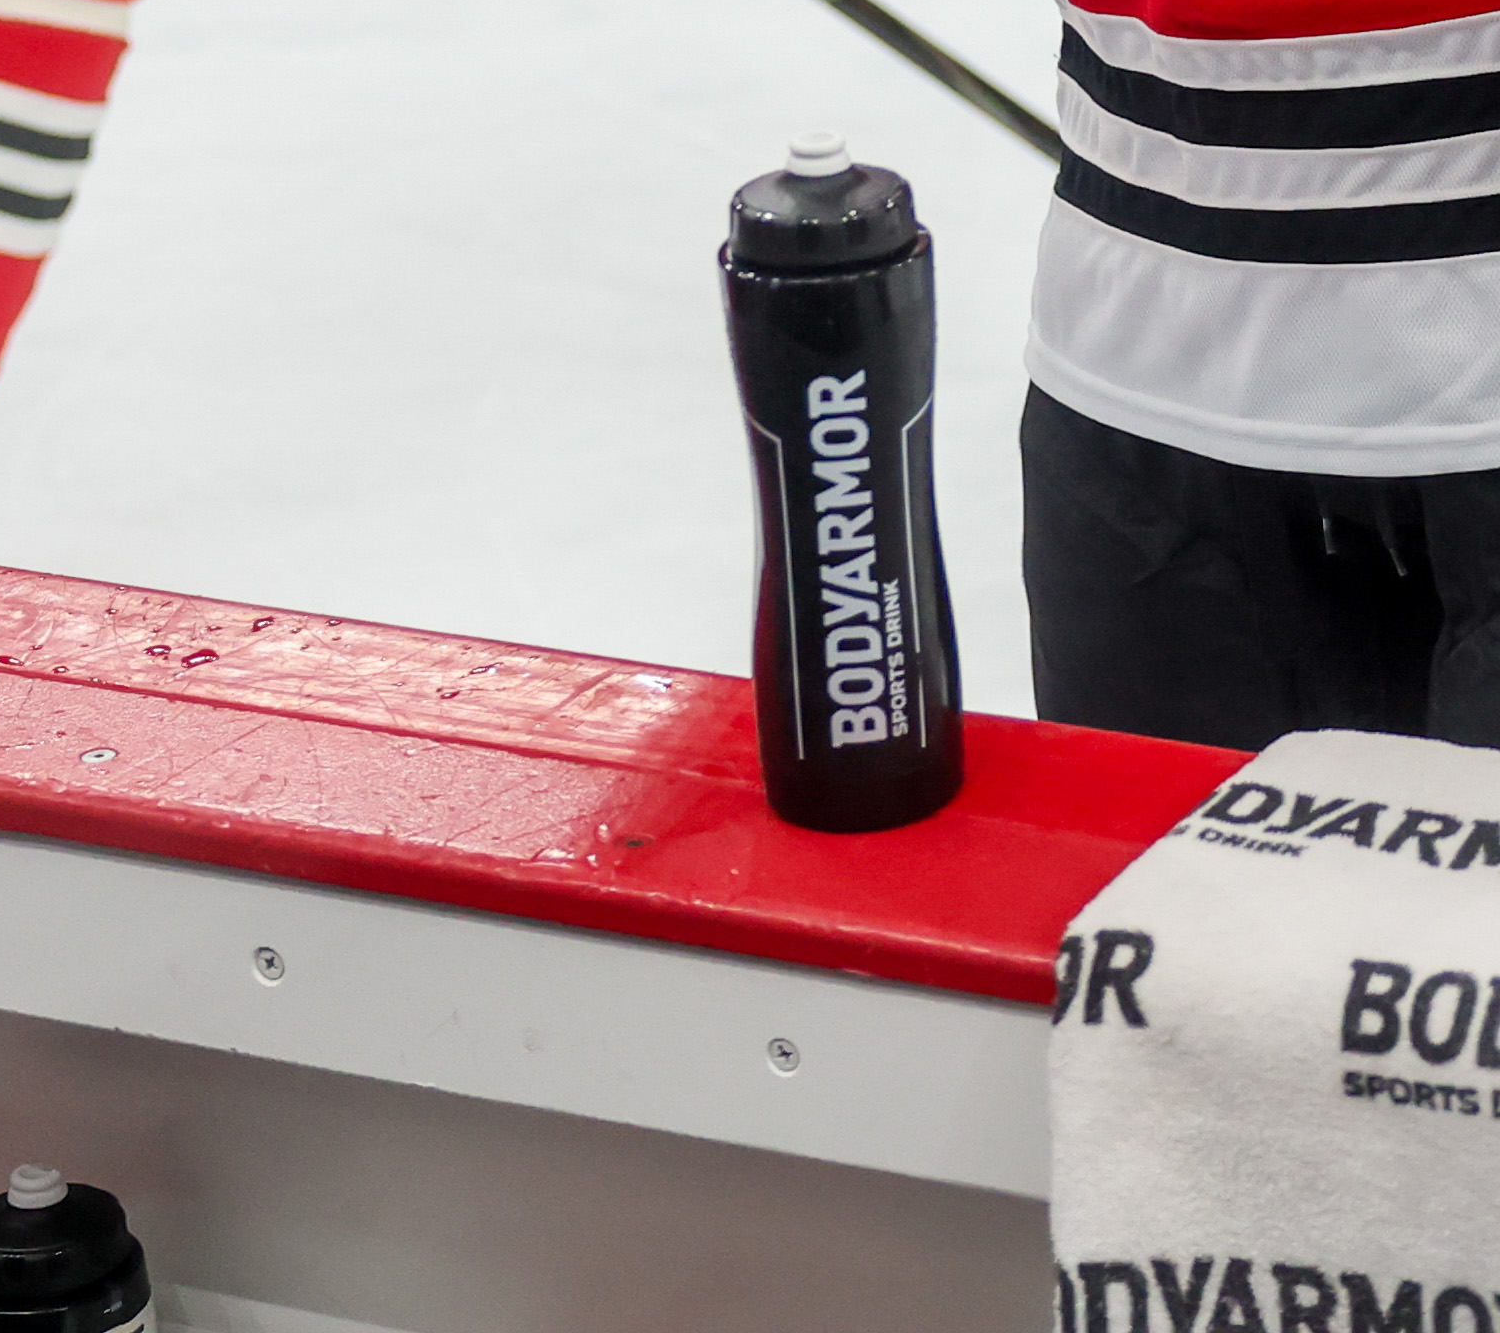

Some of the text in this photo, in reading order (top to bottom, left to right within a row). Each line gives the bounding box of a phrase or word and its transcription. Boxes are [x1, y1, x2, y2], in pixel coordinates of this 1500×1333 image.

[806, 369, 889, 749] BODYARMOR
[882, 578, 910, 737] SPORTS DRINK
[1343, 1071, 1480, 1116] SPORTS
